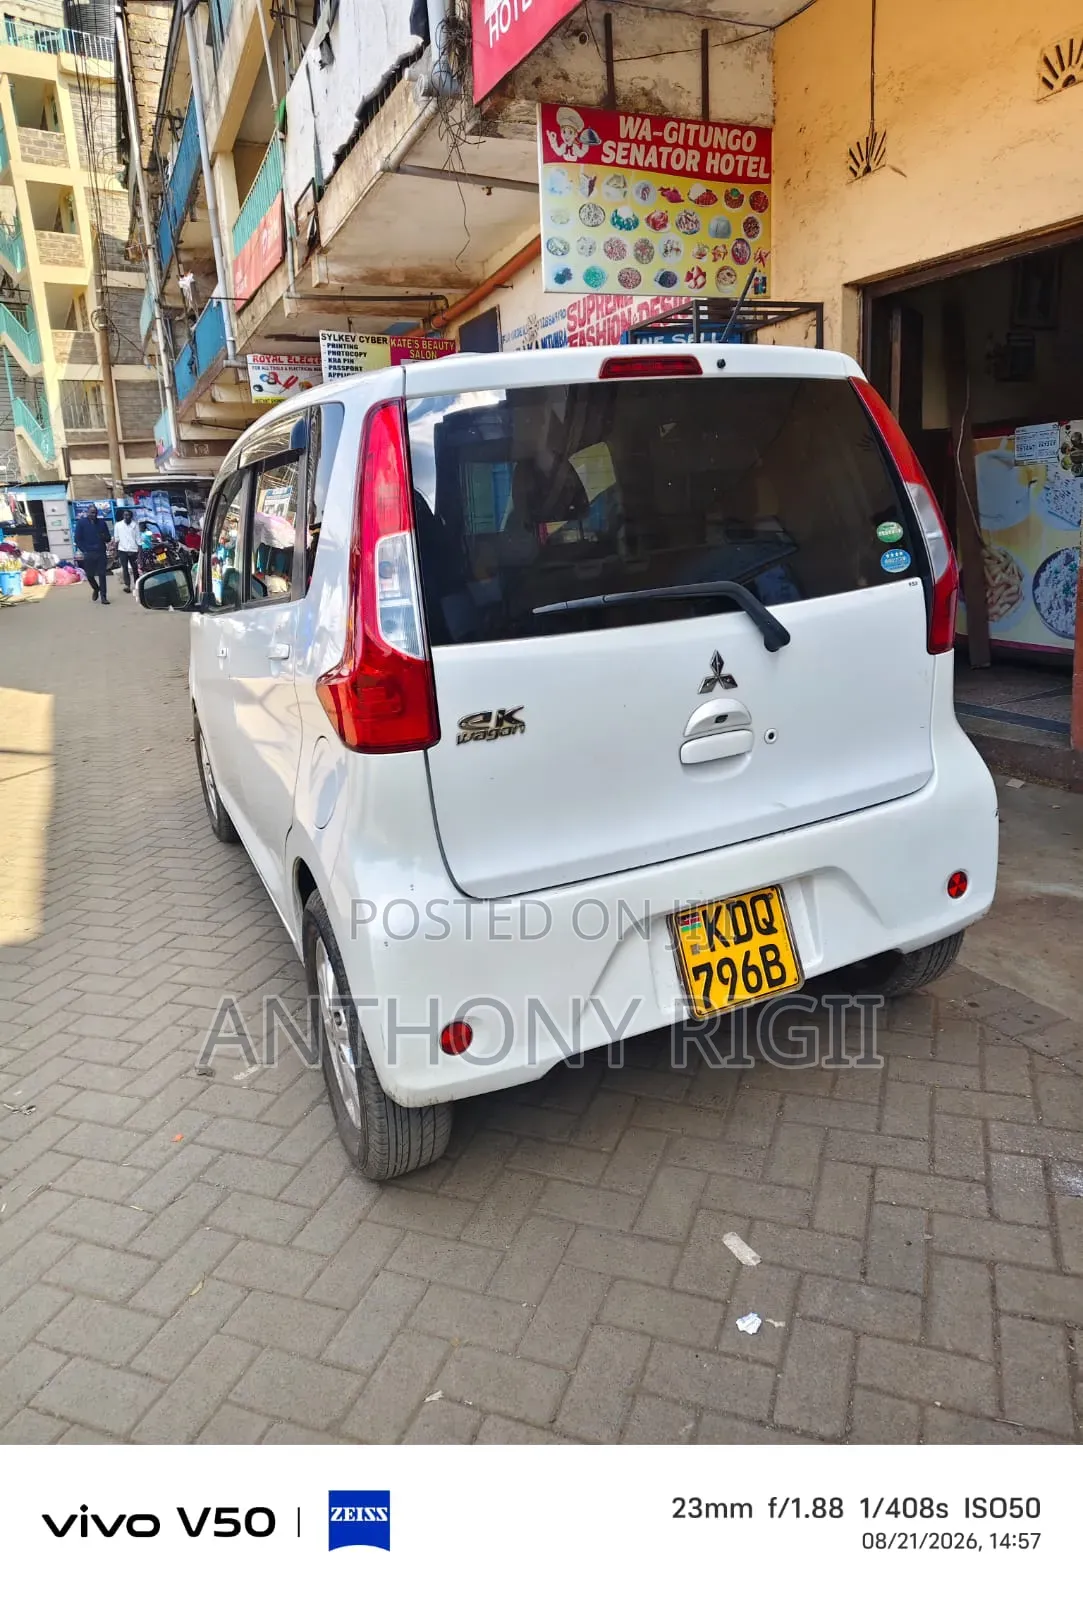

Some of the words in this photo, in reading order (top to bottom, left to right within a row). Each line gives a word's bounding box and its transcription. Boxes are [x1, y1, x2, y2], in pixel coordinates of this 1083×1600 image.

[618, 115, 757, 153] WA-GITUNGO
[601, 140, 701, 172] SENATOR
[705, 152, 770, 179] HOTEL
[321, 333, 356, 343] SYLKEV
[358, 335, 388, 344] CYBER
[390, 338, 420, 349] KATE'S
[422, 340, 455, 351] BEAUTY
[327, 342, 359, 350] PRINTING
[253, 354, 284, 363] ROYAL
[327, 350, 367, 358] PHOTOCOPY
[409, 349, 437, 359] SALON
[456, 725, 526, 746] wagon
[701, 892, 778, 953] KDQ
[691, 943, 787, 1010] 796B
